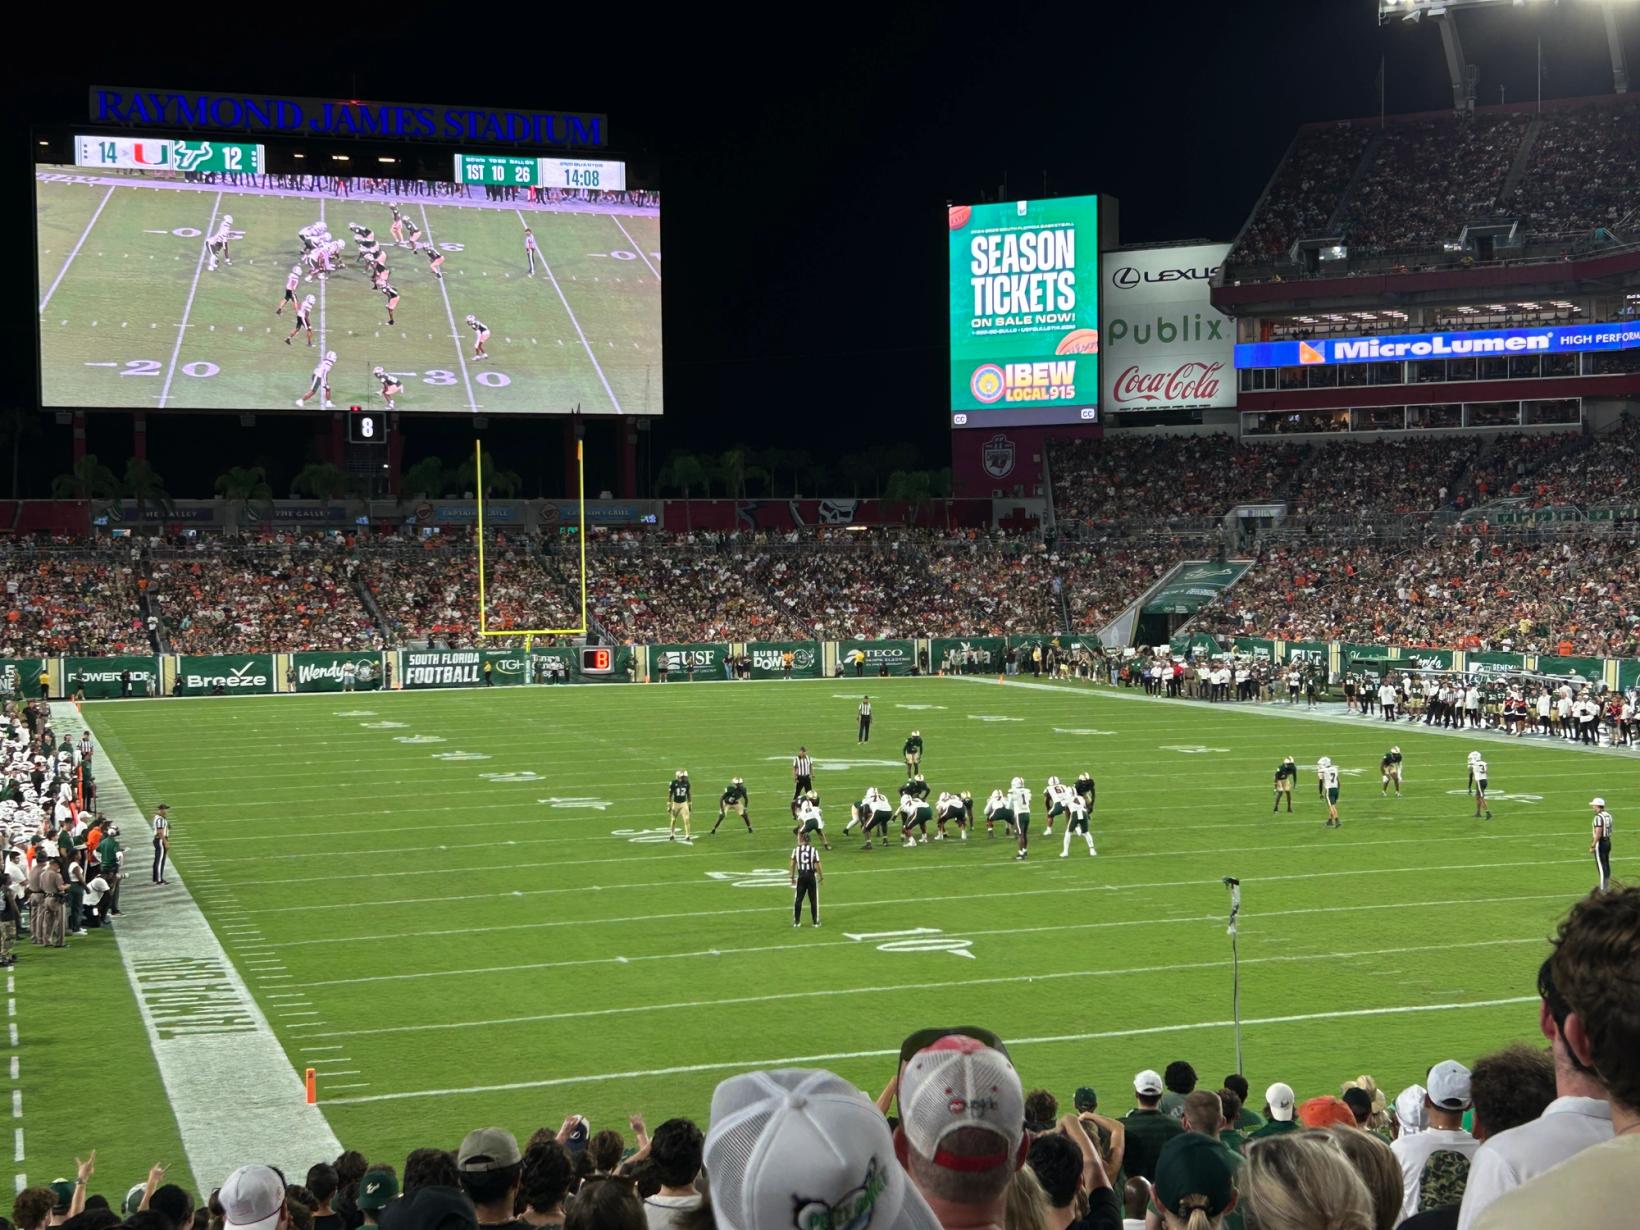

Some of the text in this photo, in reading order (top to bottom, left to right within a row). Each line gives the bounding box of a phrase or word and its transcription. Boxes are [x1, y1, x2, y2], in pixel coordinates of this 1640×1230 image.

[97, 90, 601, 145] RAYMOND JAMES STADIUM
[99, 141, 117, 164] 14
[222, 147, 243, 170] 12
[466, 164, 531, 183] 1ST 10 26
[564, 168, 600, 187] 14:08
[970, 229, 1075, 276] SEASON
[970, 270, 1076, 316] TICKETS
[971, 312, 1076, 328] ON SALE NOW!
[1108, 313, 1222, 346] Publix
[1560, 334, 1591, 346] HIGH
[1005, 360, 1076, 388] IBEW
[1113, 361, 1225, 403] Coca-Cola
[1005, 385, 1076, 402] LOCAL 915
[361, 417, 374, 438] 8
[409, 652, 480, 666] SOUTH FLORIDA
[595, 650, 608, 670] 8
[680, 650, 715, 664] USF
[864, 649, 903, 658] TECO
[187, 674, 267, 688] Breeze
[406, 666, 480, 685] FOOTBALL
[1330, 772, 1336, 783] 7
[1479, 764, 1486, 774] 3
[1021, 794, 1027, 806] 1
[801, 852, 809, 864] C
